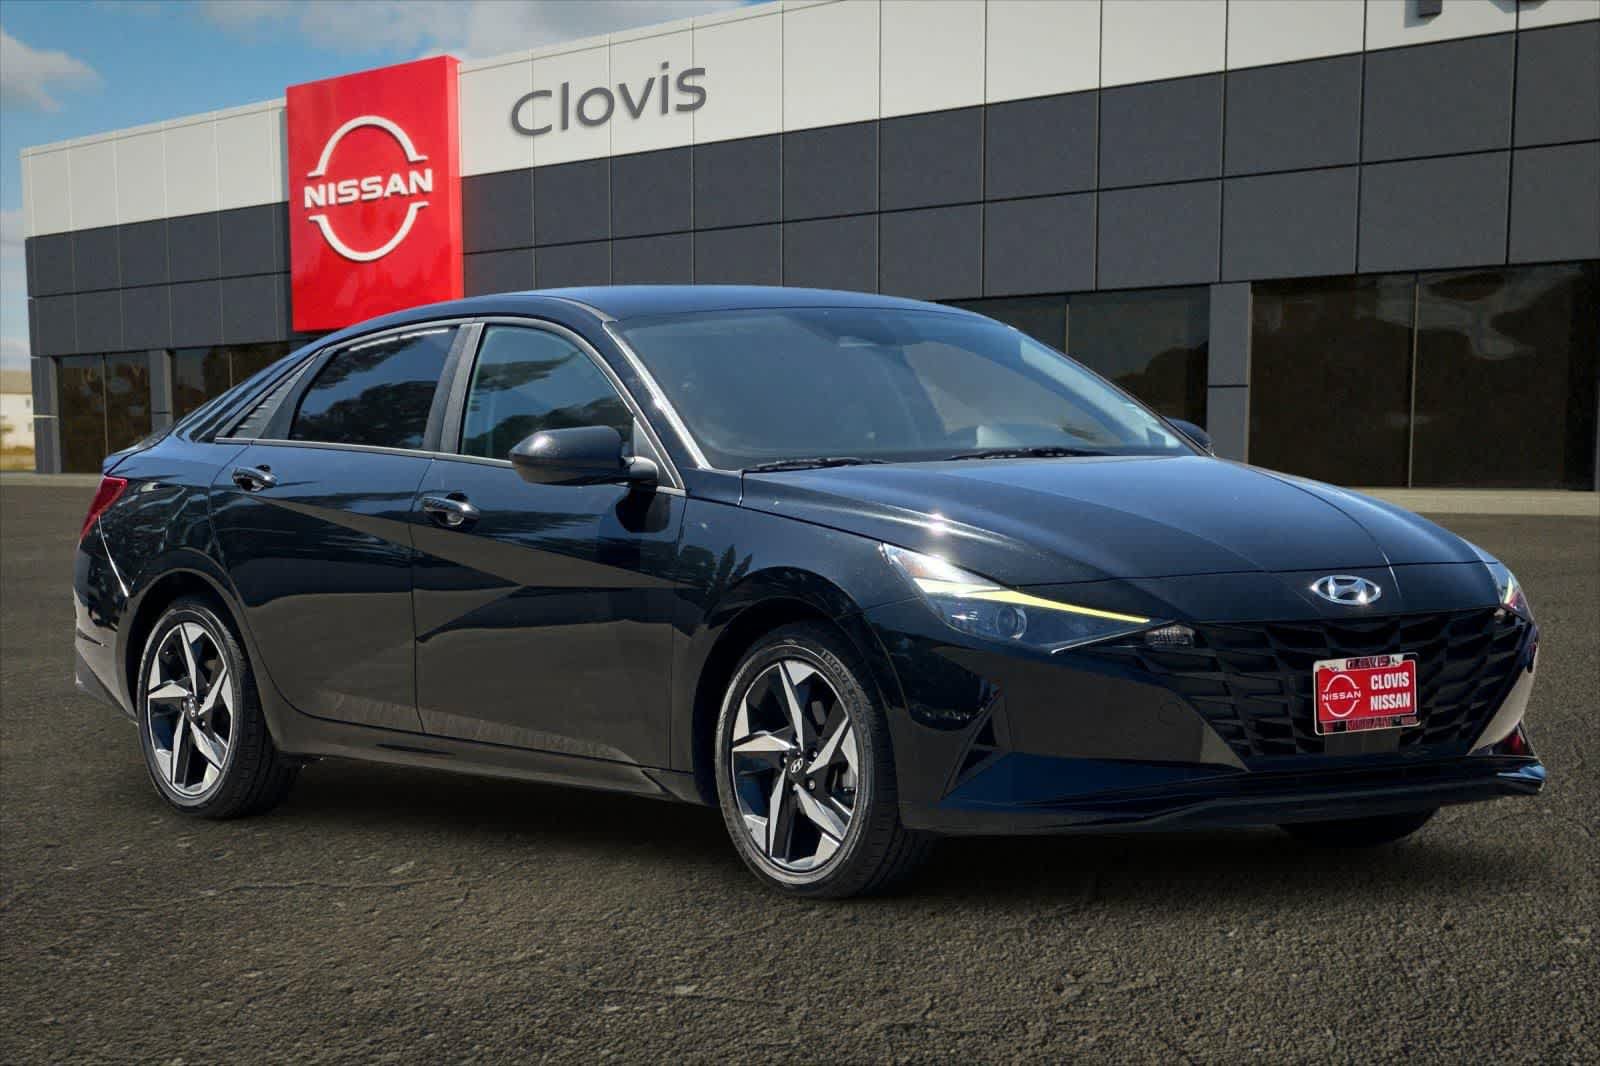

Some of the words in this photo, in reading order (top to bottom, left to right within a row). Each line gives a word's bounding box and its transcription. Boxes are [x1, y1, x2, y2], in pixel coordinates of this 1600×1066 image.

[511, 62, 707, 136] Clovis
[304, 168, 433, 209] NISSAN
[1370, 671, 1409, 690] CLOVIS
[1321, 689, 1362, 701] NISSAN
[1370, 692, 1411, 711] NISSAN
